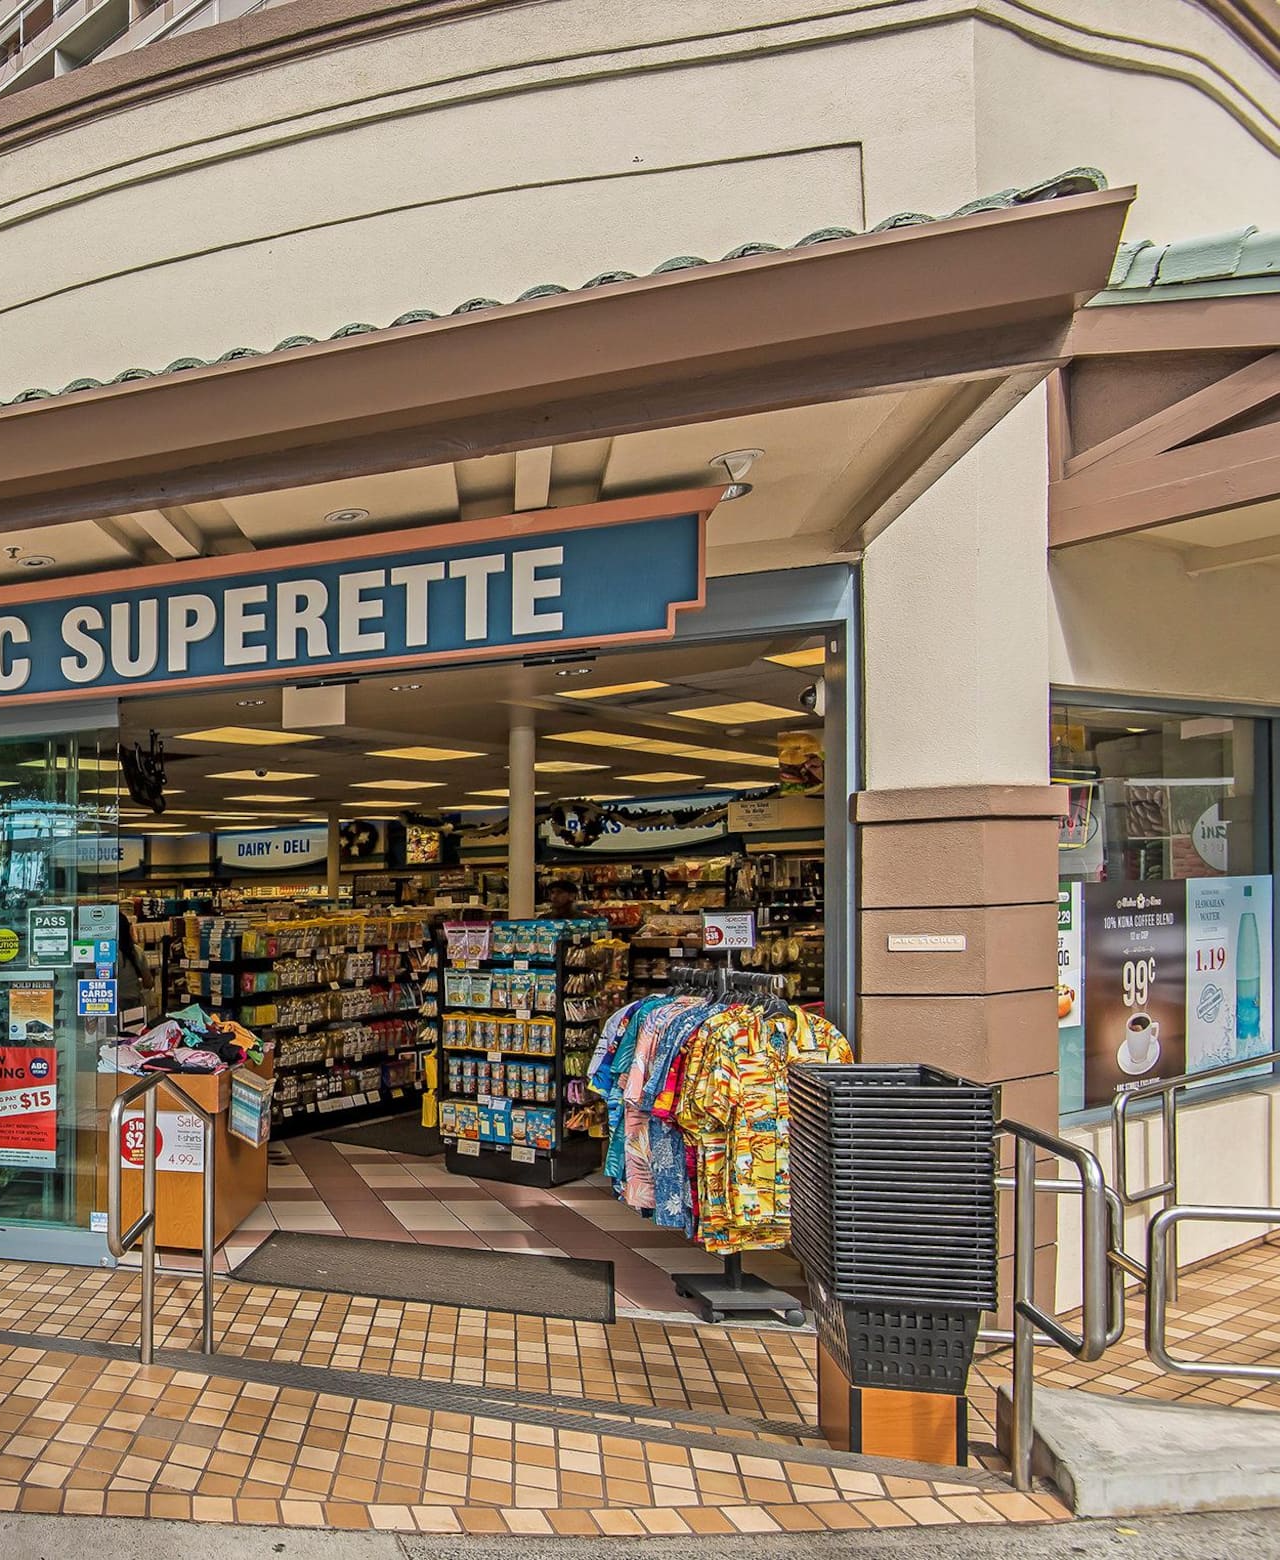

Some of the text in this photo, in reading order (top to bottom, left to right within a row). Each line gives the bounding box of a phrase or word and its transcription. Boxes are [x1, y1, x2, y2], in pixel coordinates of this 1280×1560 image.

[60, 545, 567, 684] SUPERETTE
[77, 847, 125, 861] PRODUCE
[237, 839, 311, 857] DAIRY DELI
[1194, 898, 1225, 909] HAWAIIAN
[35, 917, 66, 927] PASS
[1104, 912, 1174, 929] 10% KONA COFFEE BLEND
[1199, 911, 1220, 921] WATER
[1058, 950, 1069, 967] OG
[1196, 946, 1225, 972] 1.19
[88, 981, 106, 990] SIM
[81, 990, 114, 998] CARDS
[31, 1062, 48, 1070] ABC
[5, 1095, 18, 1103] PAY
[20, 1090, 51, 1110] $15
[129, 1121, 144, 1130] 5 fo
[177, 1115, 202, 1128] Sale
[125, 1131, 144, 1149] $2
[177, 1135, 202, 1143] t-shirts
[168, 1153, 194, 1165] 4.99
